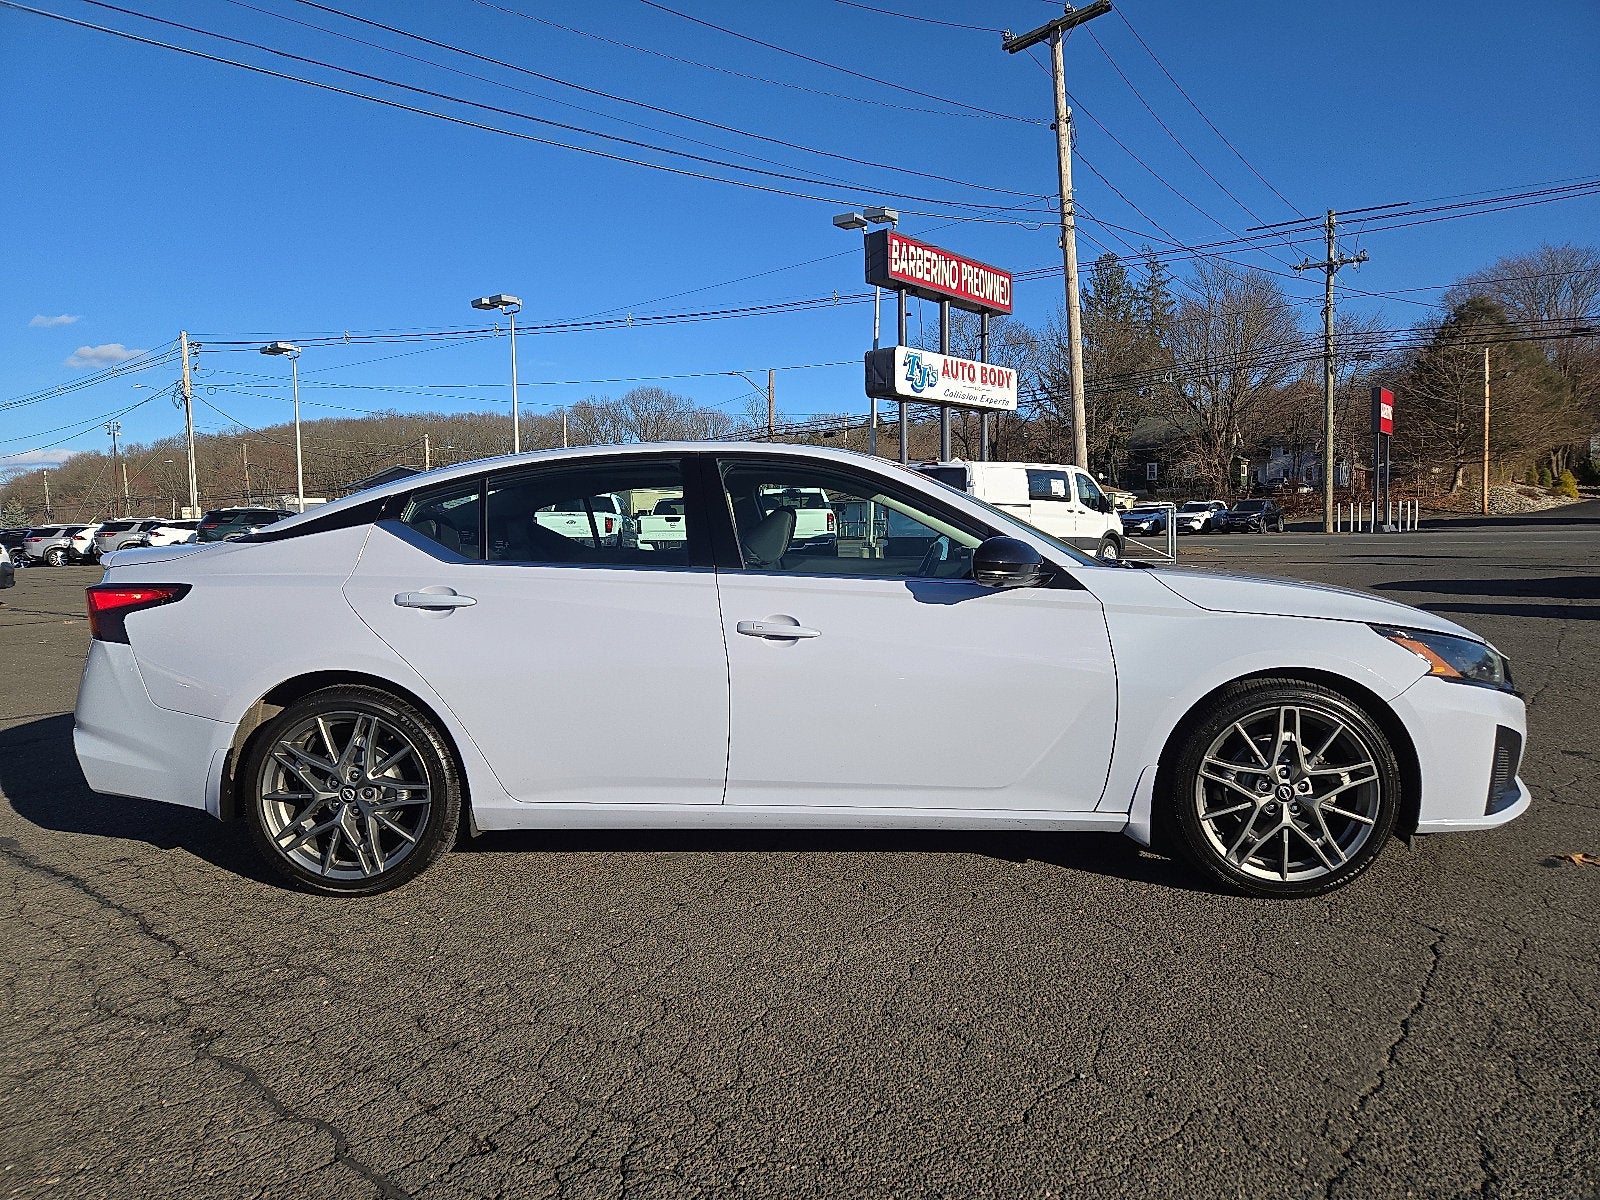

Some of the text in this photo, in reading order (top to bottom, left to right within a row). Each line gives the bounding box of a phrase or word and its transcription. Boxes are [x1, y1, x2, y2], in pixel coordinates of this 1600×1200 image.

[891, 239, 1010, 305] BARBERINO PREOWNED
[942, 358, 976, 383] AUTO
[980, 365, 1012, 389] BODY
[943, 388, 1010, 406] Collision Experts
